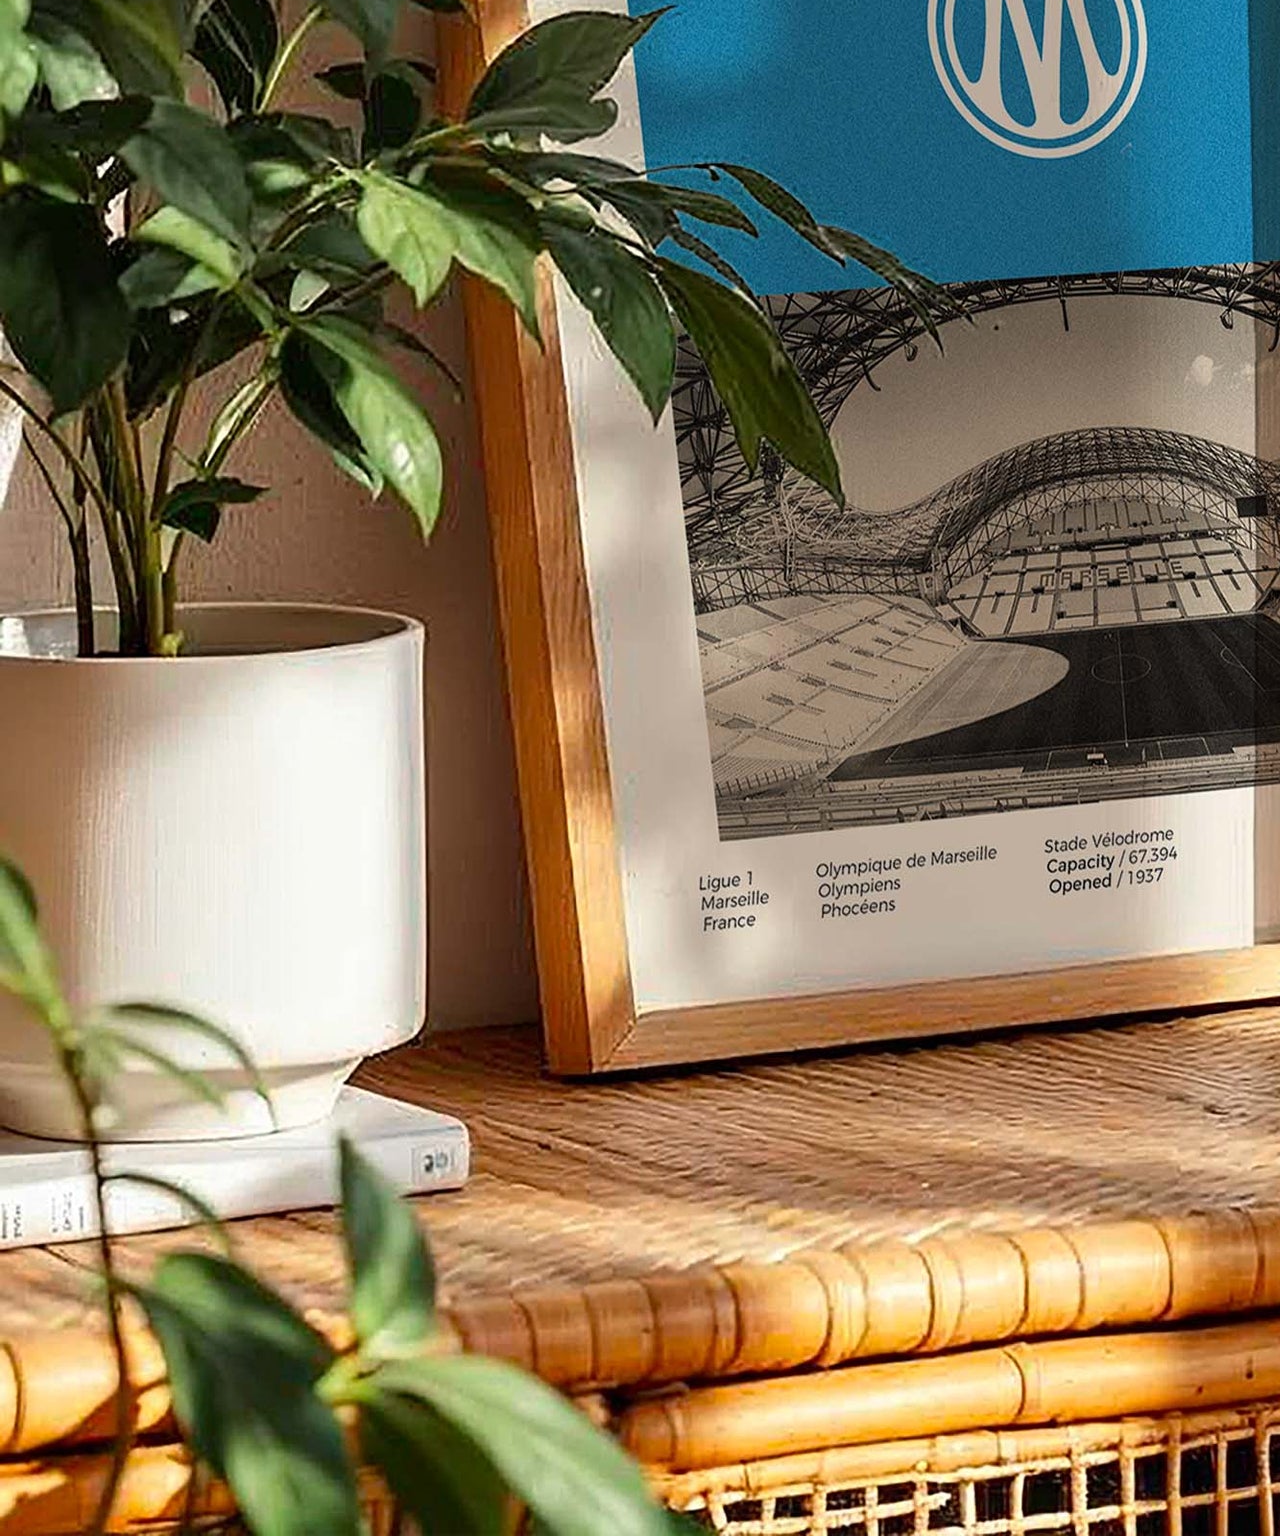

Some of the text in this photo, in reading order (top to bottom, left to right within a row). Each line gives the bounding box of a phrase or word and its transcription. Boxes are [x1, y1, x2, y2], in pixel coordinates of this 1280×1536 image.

[1040, 561, 1183, 587] MARSEILLE
[1044, 829, 1174, 854] Stade Vélodrome
[815, 845, 997, 880] Olympique de Marseille
[1046, 853, 1115, 875] Capacity
[699, 870, 752, 893] Ligue 1
[818, 877, 901, 900] Olympiens
[1049, 872, 1112, 896] Opened
[1128, 867, 1164, 885] 1937
[701, 890, 769, 911] Marseille
[821, 898, 896, 919] Phocéens
[703, 915, 756, 932] France
